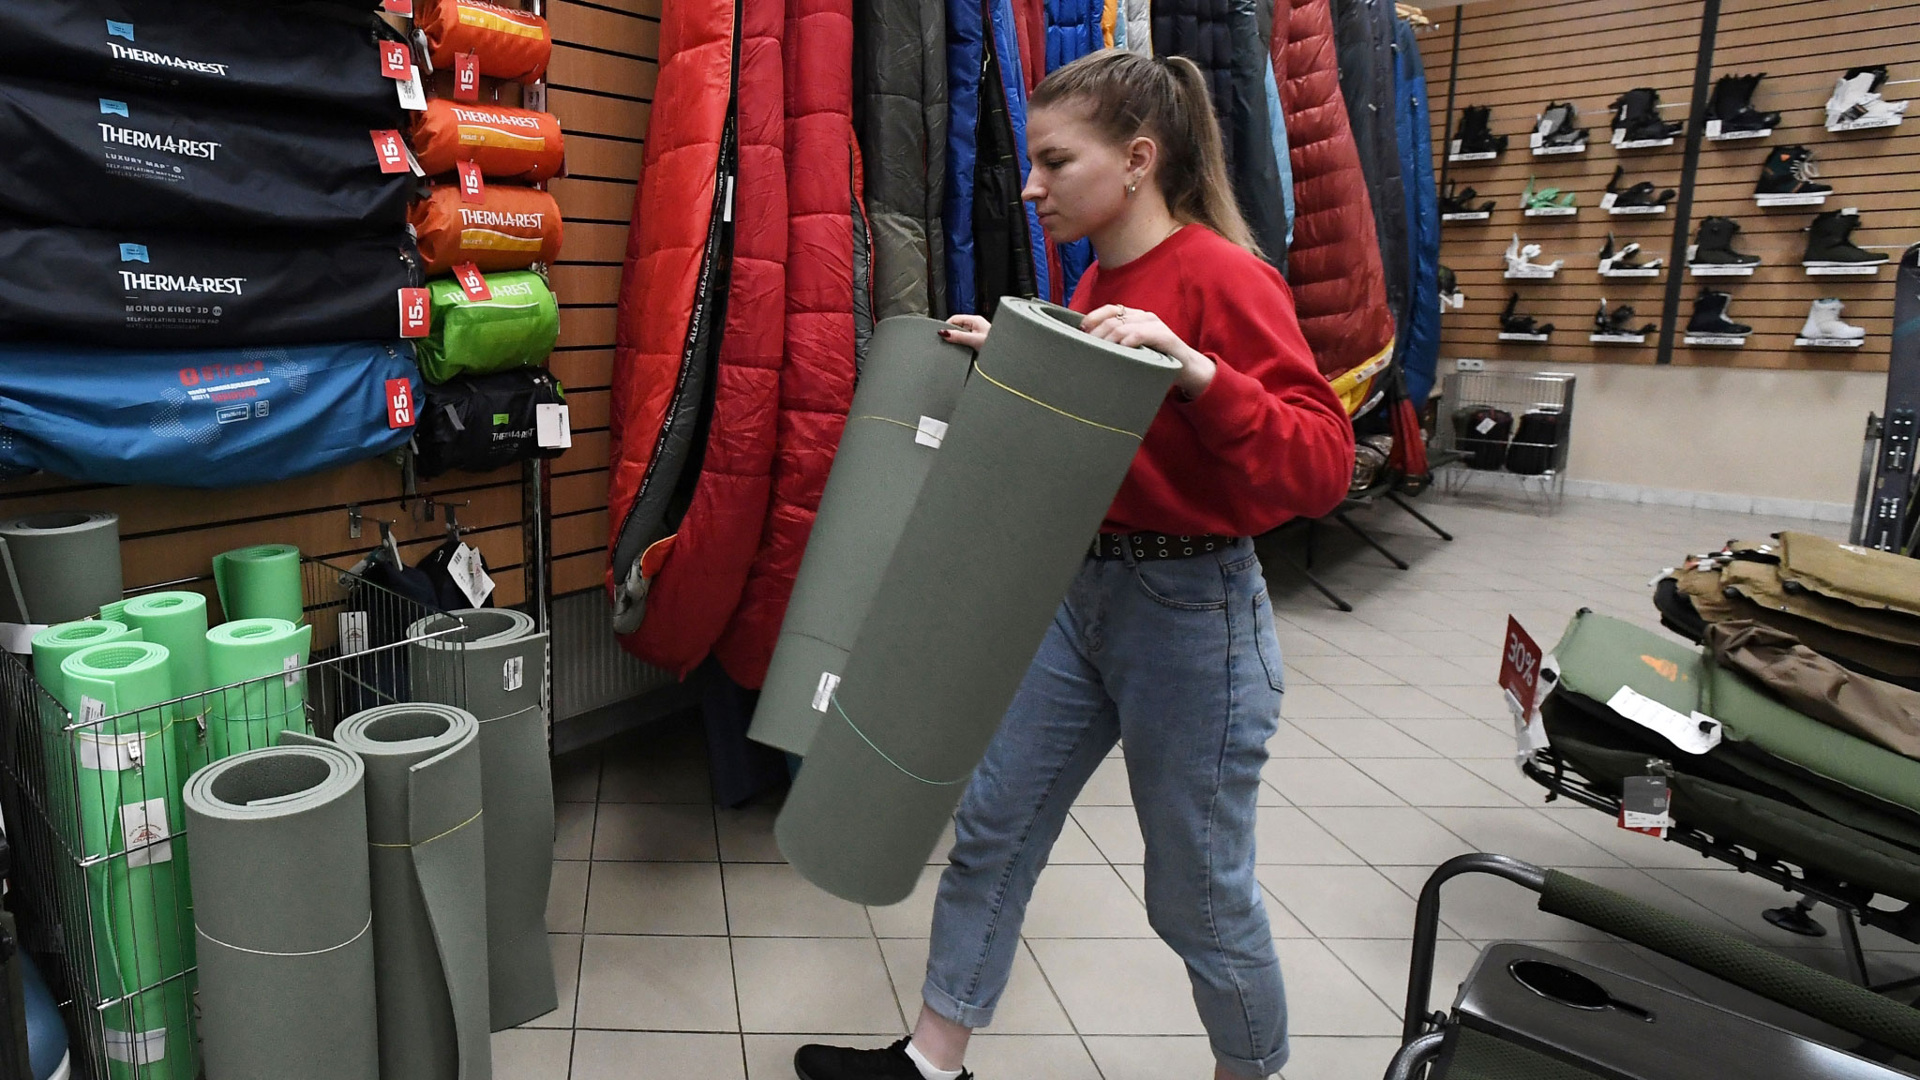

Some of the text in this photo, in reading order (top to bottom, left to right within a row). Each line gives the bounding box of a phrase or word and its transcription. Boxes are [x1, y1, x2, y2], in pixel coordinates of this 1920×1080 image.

[388, 48, 404, 71] 15%
[461, 62, 474, 91] 15%
[105, 152, 142, 164] LUXURY
[384, 136, 401, 164] 15%
[465, 169, 479, 195] 15%
[466, 270, 483, 294] 15%
[125, 305, 165, 313] MONDO
[167, 306, 192, 314] KING
[409, 297, 423, 328] 15%
[393, 386, 410, 424] 25%
[1508, 632, 1536, 687] 30%
